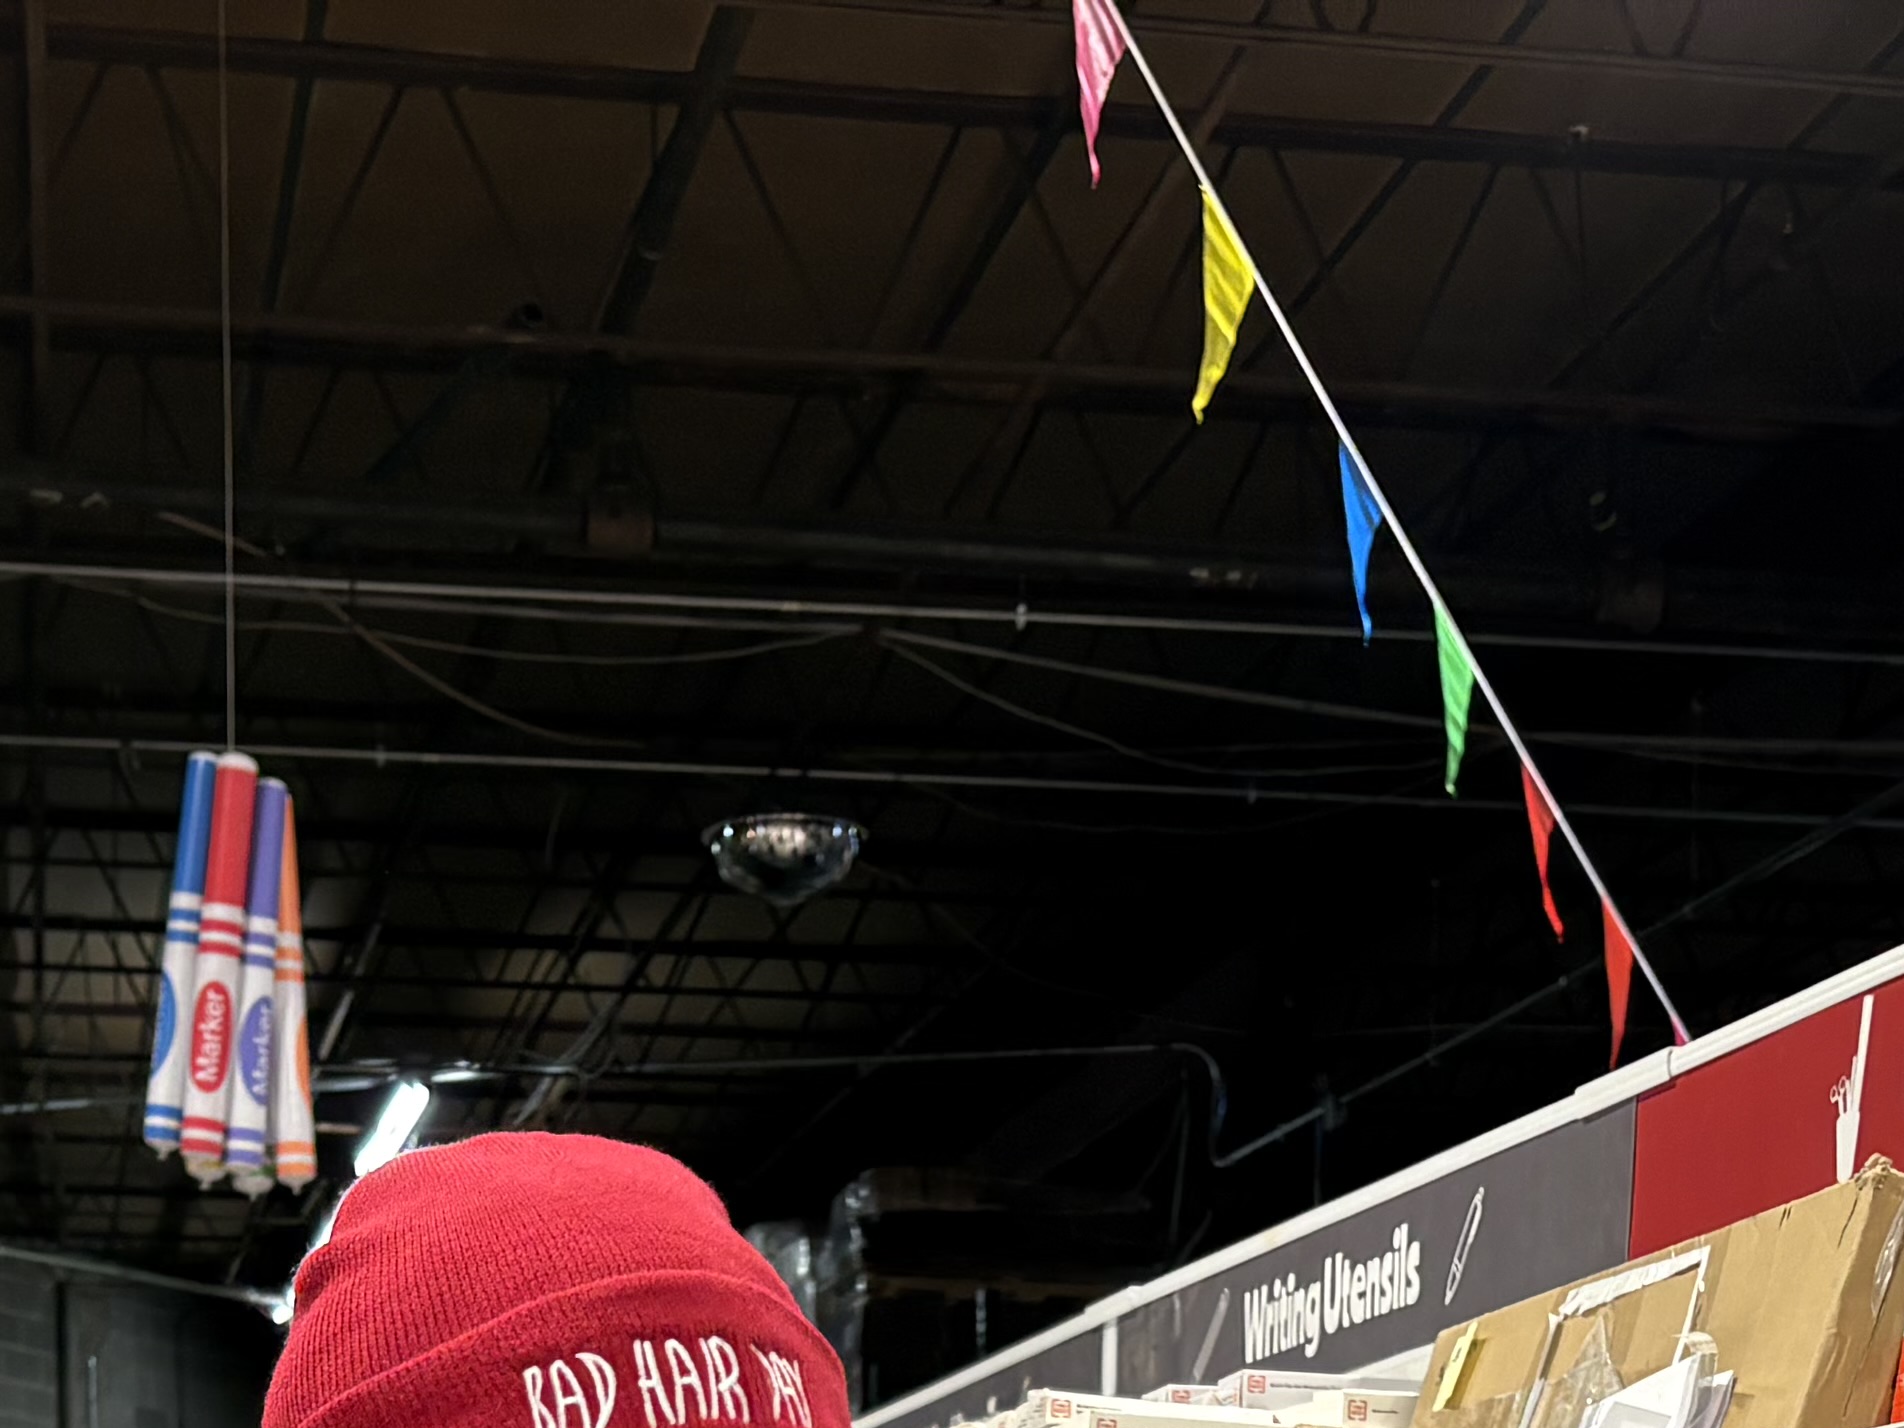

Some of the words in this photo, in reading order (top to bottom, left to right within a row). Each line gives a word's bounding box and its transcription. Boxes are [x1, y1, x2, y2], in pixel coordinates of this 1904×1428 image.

[195, 989, 226, 1082] Marker
[1243, 1268, 1321, 1363] Writing
[1323, 1222, 1422, 1335] Utensils
